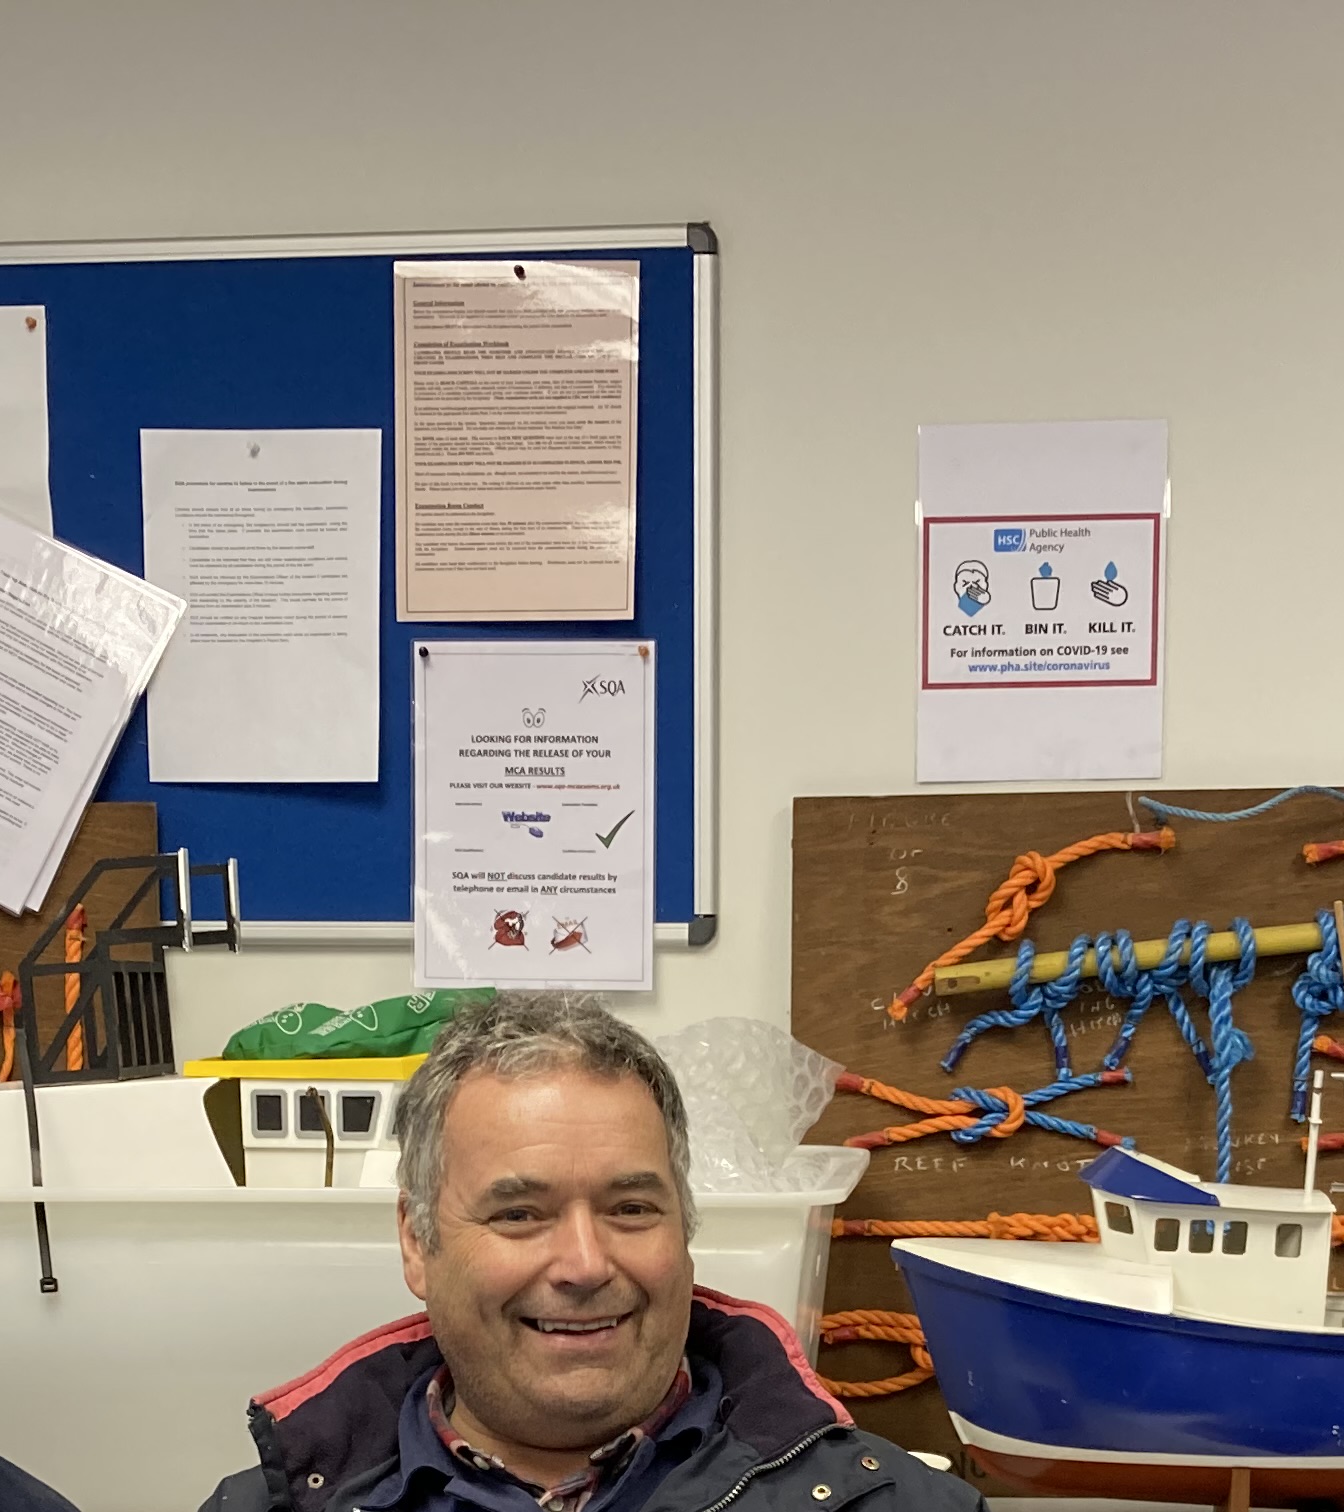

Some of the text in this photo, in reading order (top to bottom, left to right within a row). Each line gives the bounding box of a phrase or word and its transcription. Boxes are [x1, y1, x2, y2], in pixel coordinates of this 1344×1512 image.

[998, 528, 1091, 546] HSC Public Health
[1030, 542, 1064, 554] Agency
[943, 624, 1006, 636] CATCH IT.
[1025, 624, 1067, 634] BIN IT.
[1088, 622, 1136, 634] KILL IT.
[950, 646, 1129, 658] For information on COVID-19 see
[968, 660, 1110, 674] www.pha.site/coronavirus
[599, 680, 626, 696] SQA
[471, 735, 598, 744] LOOKING FOR INFORMATION
[459, 750, 611, 758] REGARDING THE RELEASE OF YOUR
[505, 767, 565, 776] MCA RESULTS
[502, 811, 551, 822] Website
[452, 872, 618, 882] SQA will NOT discuss candidate results by
[453, 886, 494, 894] telephone
[540, 886, 558, 894] ANY
[560, 886, 616, 894] circumstances
[894, 1156, 967, 1174] REEF
